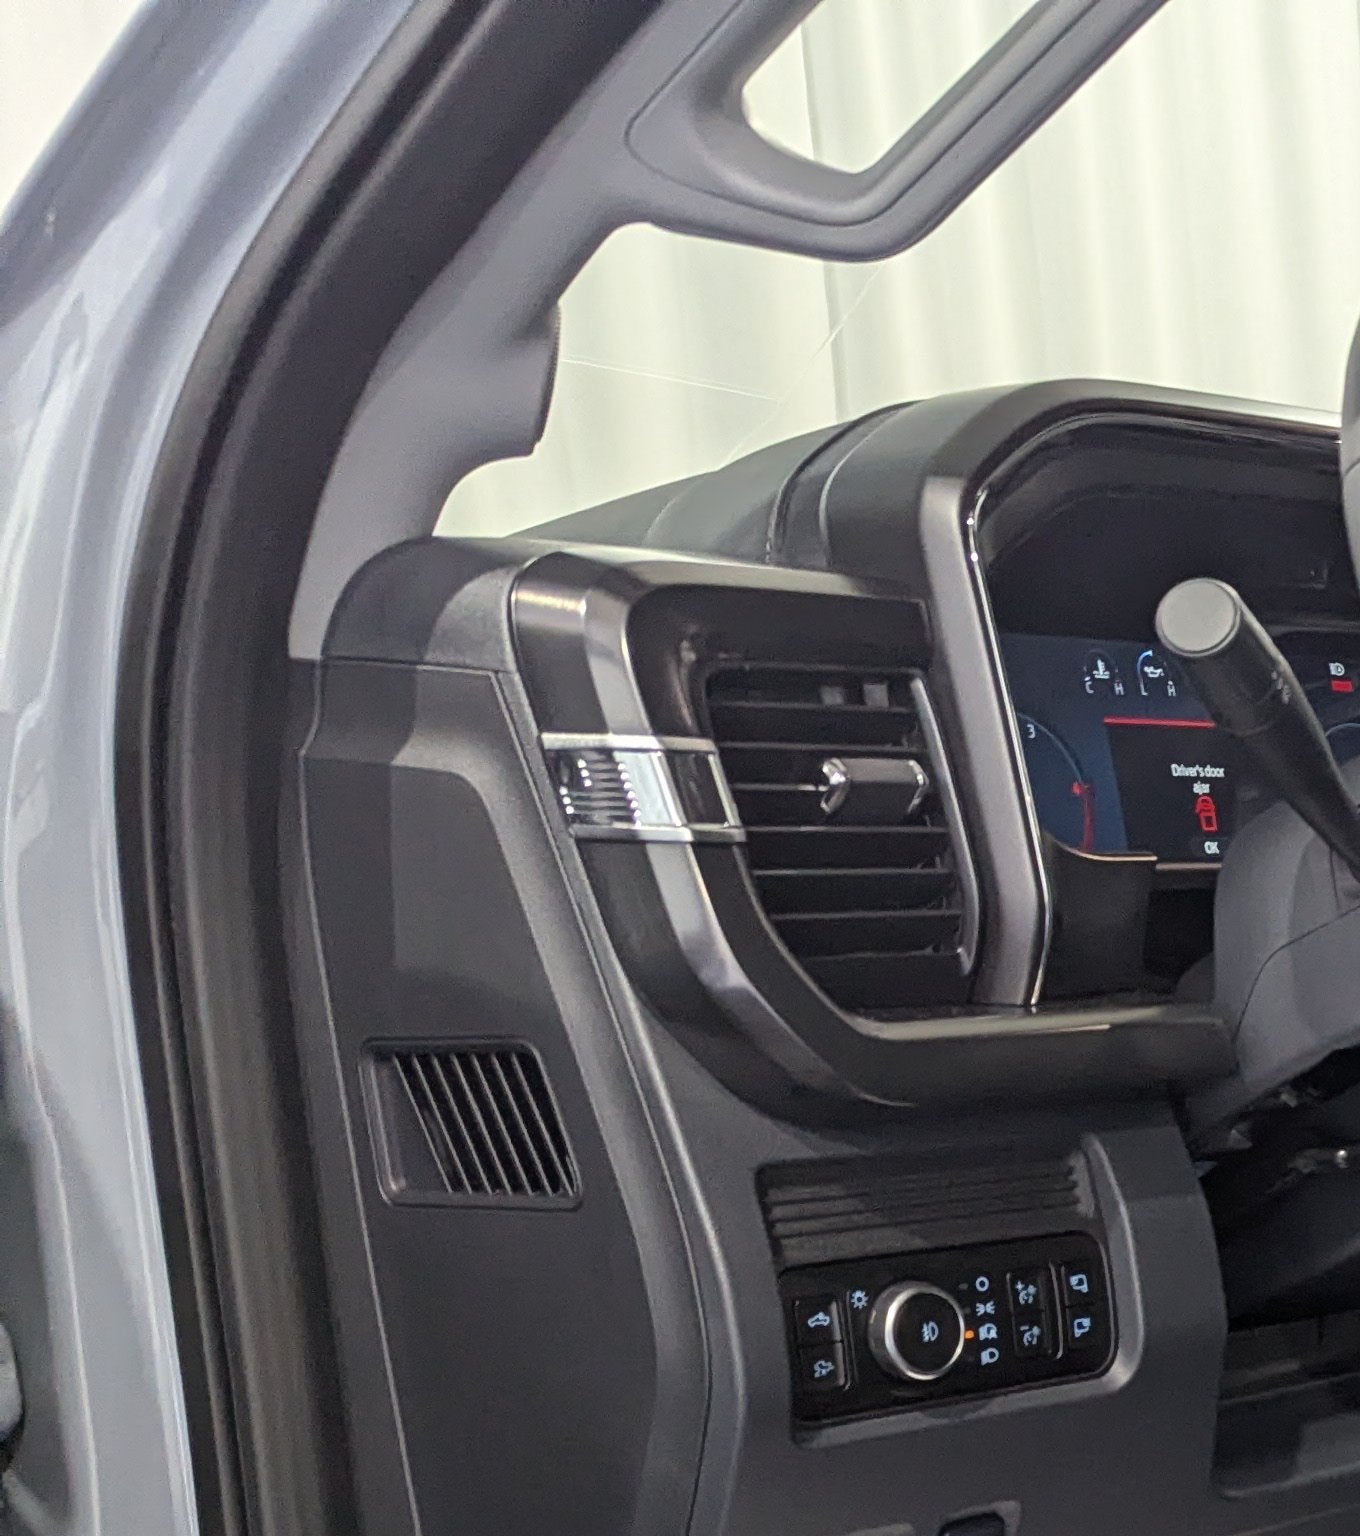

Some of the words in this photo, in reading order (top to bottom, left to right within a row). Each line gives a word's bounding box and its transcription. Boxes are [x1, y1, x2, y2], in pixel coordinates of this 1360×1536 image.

[1026, 723, 1036, 739] 3
[1170, 763, 1204, 778] Driver's
[1204, 764, 1225, 778] door
[1192, 781, 1211, 795] ajar
[1204, 841, 1220, 855] OK
